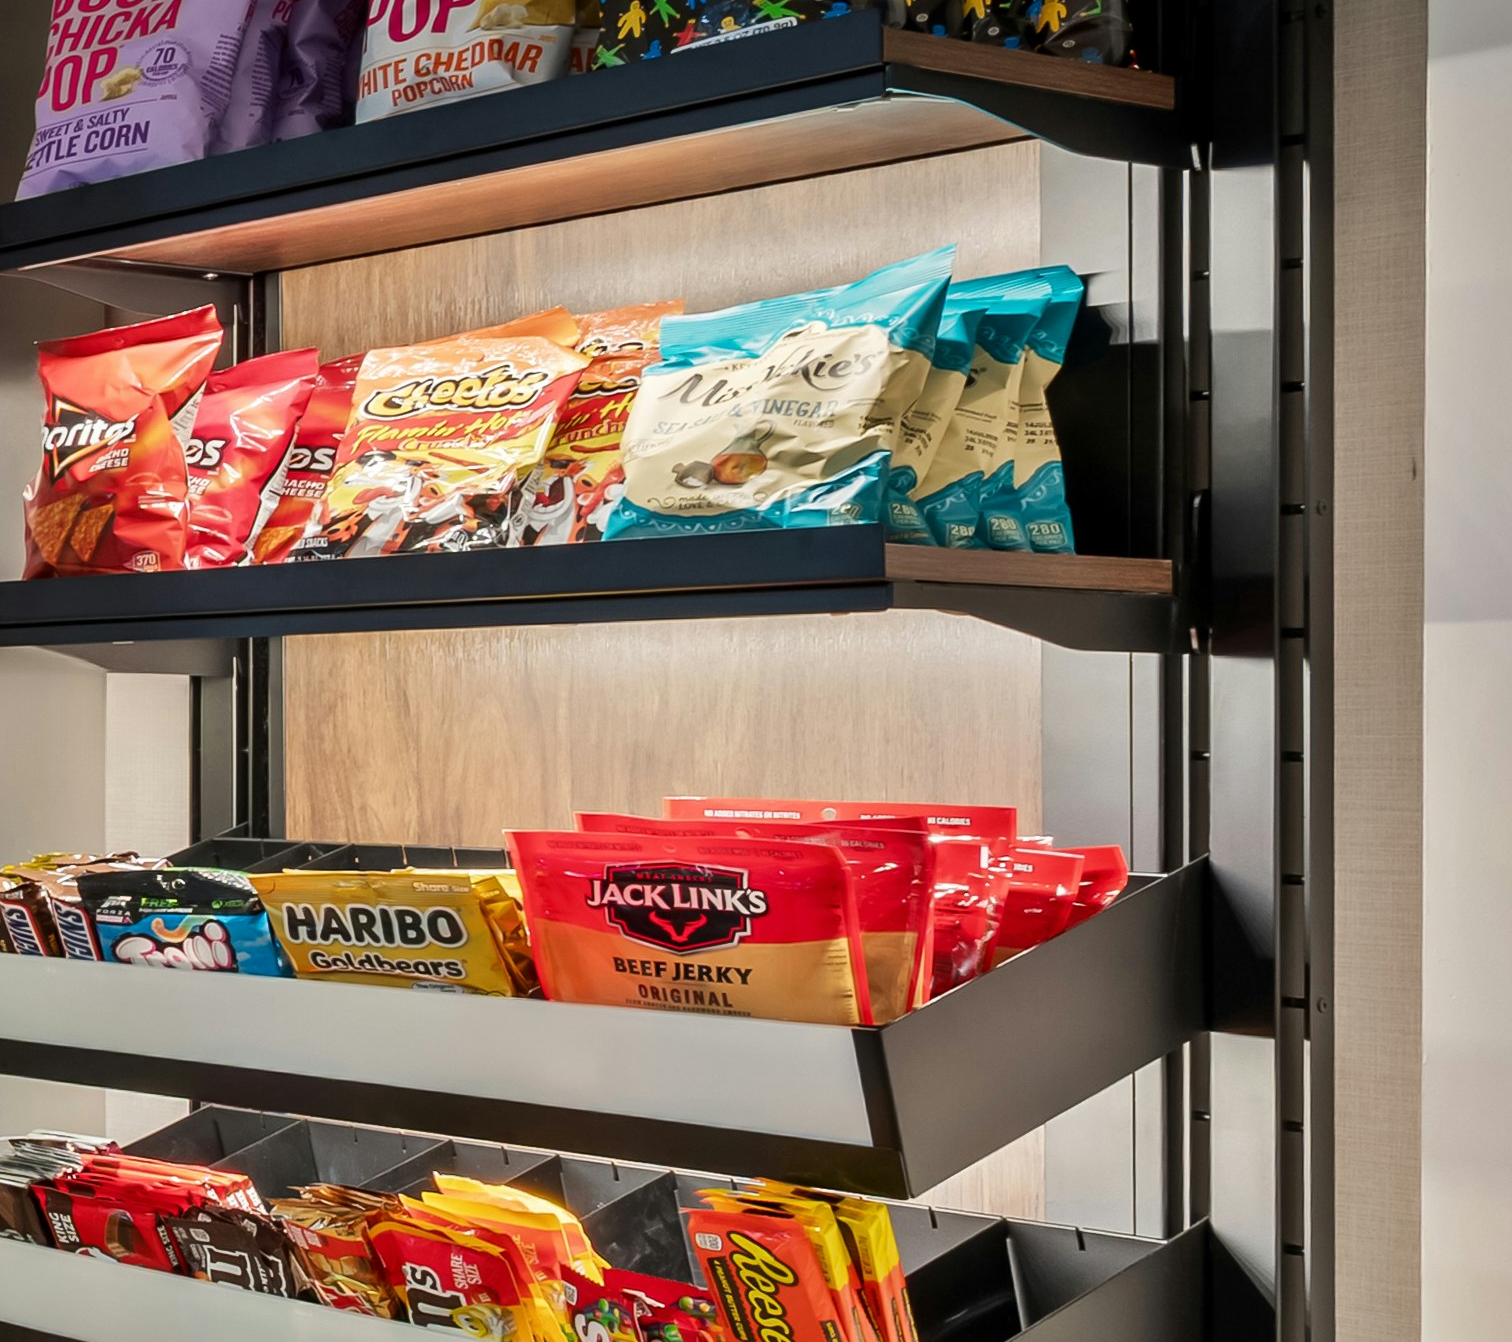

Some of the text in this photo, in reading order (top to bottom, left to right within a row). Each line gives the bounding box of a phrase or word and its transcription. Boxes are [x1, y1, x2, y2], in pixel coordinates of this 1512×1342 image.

[154, 47, 176, 65] 70
[358, 38, 544, 100] HITE CHEDDAR
[391, 71, 474, 107] POPCORN
[74, 118, 84, 134] &
[87, 108, 131, 130] SALTY
[24, 121, 151, 172] ETTLE CORN
[367, 365, 550, 418] Cheetos
[282, 488, 324, 499] HEESE
[678, 501, 702, 510] LOVE
[991, 518, 1017, 531] 280
[1030, 524, 1061, 536] 280
[136, 553, 156, 566] 370
[937, 817, 970, 825] CALORIES
[413, 882, 449, 893] Share
[587, 880, 767, 915] JACK LINK'S
[141, 898, 178, 907] FREE
[55, 904, 94, 961] SNIC
[284, 905, 466, 947] HARIBO
[115, 922, 230, 969] Trolli
[311, 951, 465, 978] Goldbears
[613, 957, 753, 985] BEEF JERKY
[638, 984, 733, 1008] ORIGINAL
[49, 1212, 70, 1243] KING
[59, 1215, 80, 1243] SIZE
[451, 1253, 468, 1289] SHARE
[464, 1262, 482, 1286] SIZE
[716, 1265, 731, 1294] PEANUT
[725, 1293, 738, 1318] BUTTER
[734, 1317, 748, 1342] CUPS
